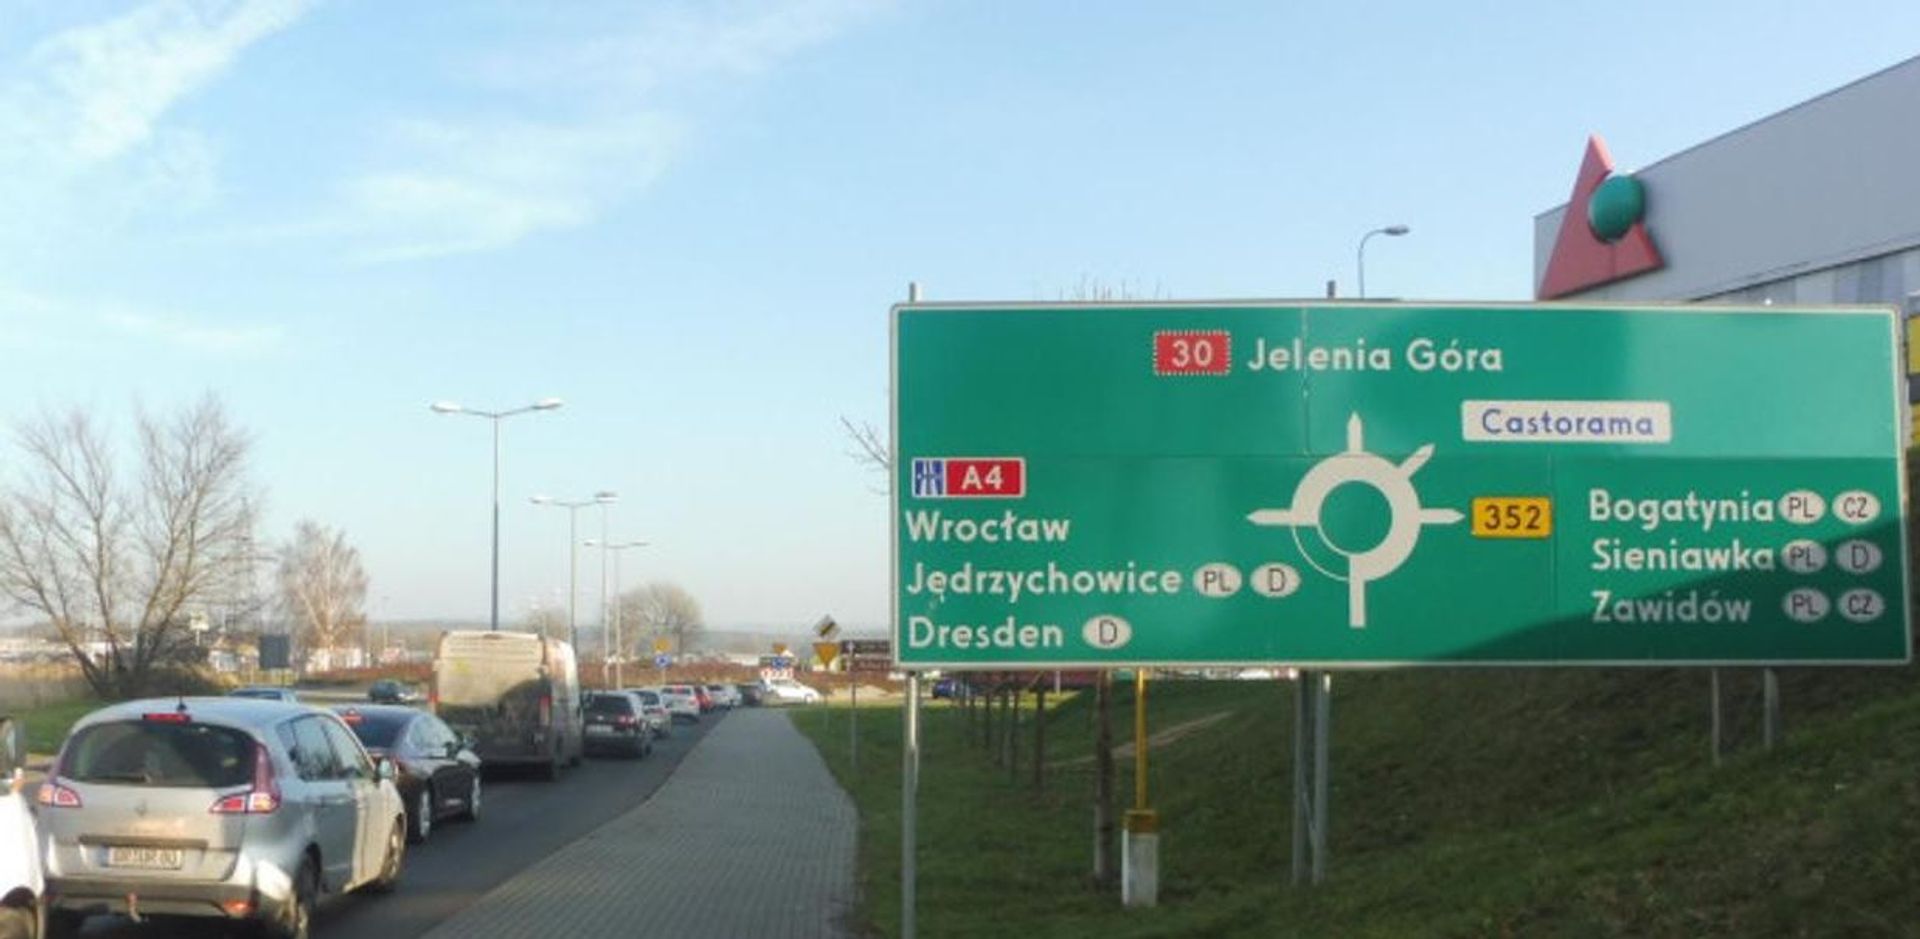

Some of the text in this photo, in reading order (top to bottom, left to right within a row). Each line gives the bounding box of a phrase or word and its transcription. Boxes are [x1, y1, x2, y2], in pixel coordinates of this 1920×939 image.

[1171, 339, 1503, 371] 30 Jelenia Góra
[1482, 409, 1654, 436] Castorama
[961, 464, 1004, 490] A4
[906, 510, 1071, 542] Wrocław
[1484, 505, 1541, 530] 352
[1590, 489, 1868, 531] Bogatynia PL CZ
[1591, 539, 1869, 572] Sieniawka PL D
[907, 562, 1286, 603] Jędrzychowice PL D
[1591, 590, 1874, 622] Zawidów PL CZ
[908, 614, 1118, 648] Dresden D
